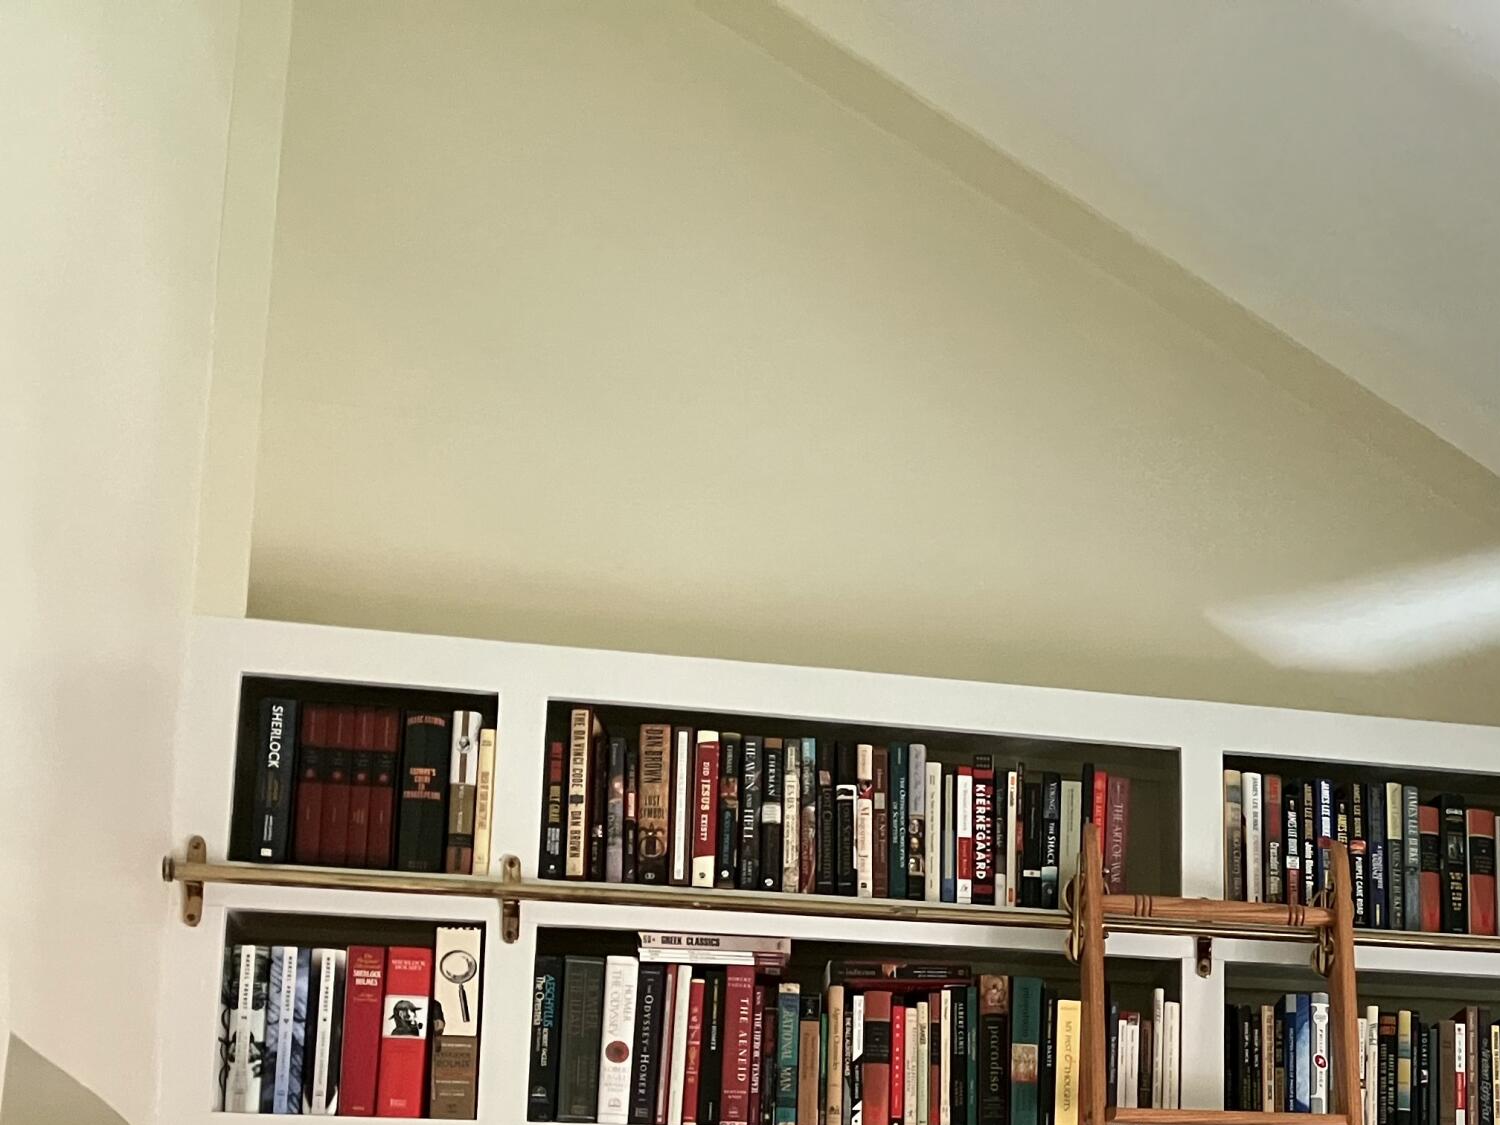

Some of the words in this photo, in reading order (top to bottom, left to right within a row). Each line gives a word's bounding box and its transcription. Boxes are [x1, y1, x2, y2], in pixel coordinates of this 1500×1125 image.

[574, 713, 587, 727] THE
[268, 705, 284, 767] SHERLOCK
[573, 730, 585, 742] DA
[646, 729, 664, 747] DAN
[573, 744, 585, 765] VINCI
[645, 750, 663, 784] BROWN
[744, 742, 757, 789] HEAVEN
[572, 768, 583, 788] CODE
[702, 761, 710, 776] DID
[767, 755, 776, 797] EHRMAN
[700, 779, 712, 811] JESUS
[1049, 782, 1057, 810] YOUNG
[1321, 781, 1330, 802] JAMES
[1408, 790, 1417, 818] JAMES
[570, 811, 582, 823] DAN
[1321, 804, 1330, 816] LEE
[700, 814, 708, 841] EXIST?
[742, 809, 756, 843] HELL
[975, 784, 987, 880] KIERKEGAARD
[1322, 817, 1331, 837] BURKE
[1408, 821, 1417, 835] LEE
[569, 826, 581, 858] BROWN
[1047, 836, 1057, 864] SHACK
[1409, 838, 1419, 864] BURKE
[1355, 856, 1363, 878] PURPLE
[1355, 880, 1363, 897] CANE
[1356, 899, 1364, 915] ROAD
[536, 976, 545, 990] The
[533, 991, 544, 1026] Oresteia
[543, 975, 555, 1027] AESCHYLUS
[739, 998, 749, 1023] THE
[640, 994, 653, 1045] ODYSSEY
[754, 1012, 762, 1024] THE
[752, 1027, 762, 1060] HEROIC
[782, 1010, 795, 1060] RATIONAL
[1368, 1023, 1377, 1045] World
[737, 1030, 748, 1082] AENEID
[988, 1025, 1001, 1092] paradiso
[638, 1054, 649, 1095] HOMER
[751, 1063, 760, 1094] TEMPER
[780, 1066, 792, 1092] MAN
[1062, 1066, 1072, 1112] THOUGHTS
